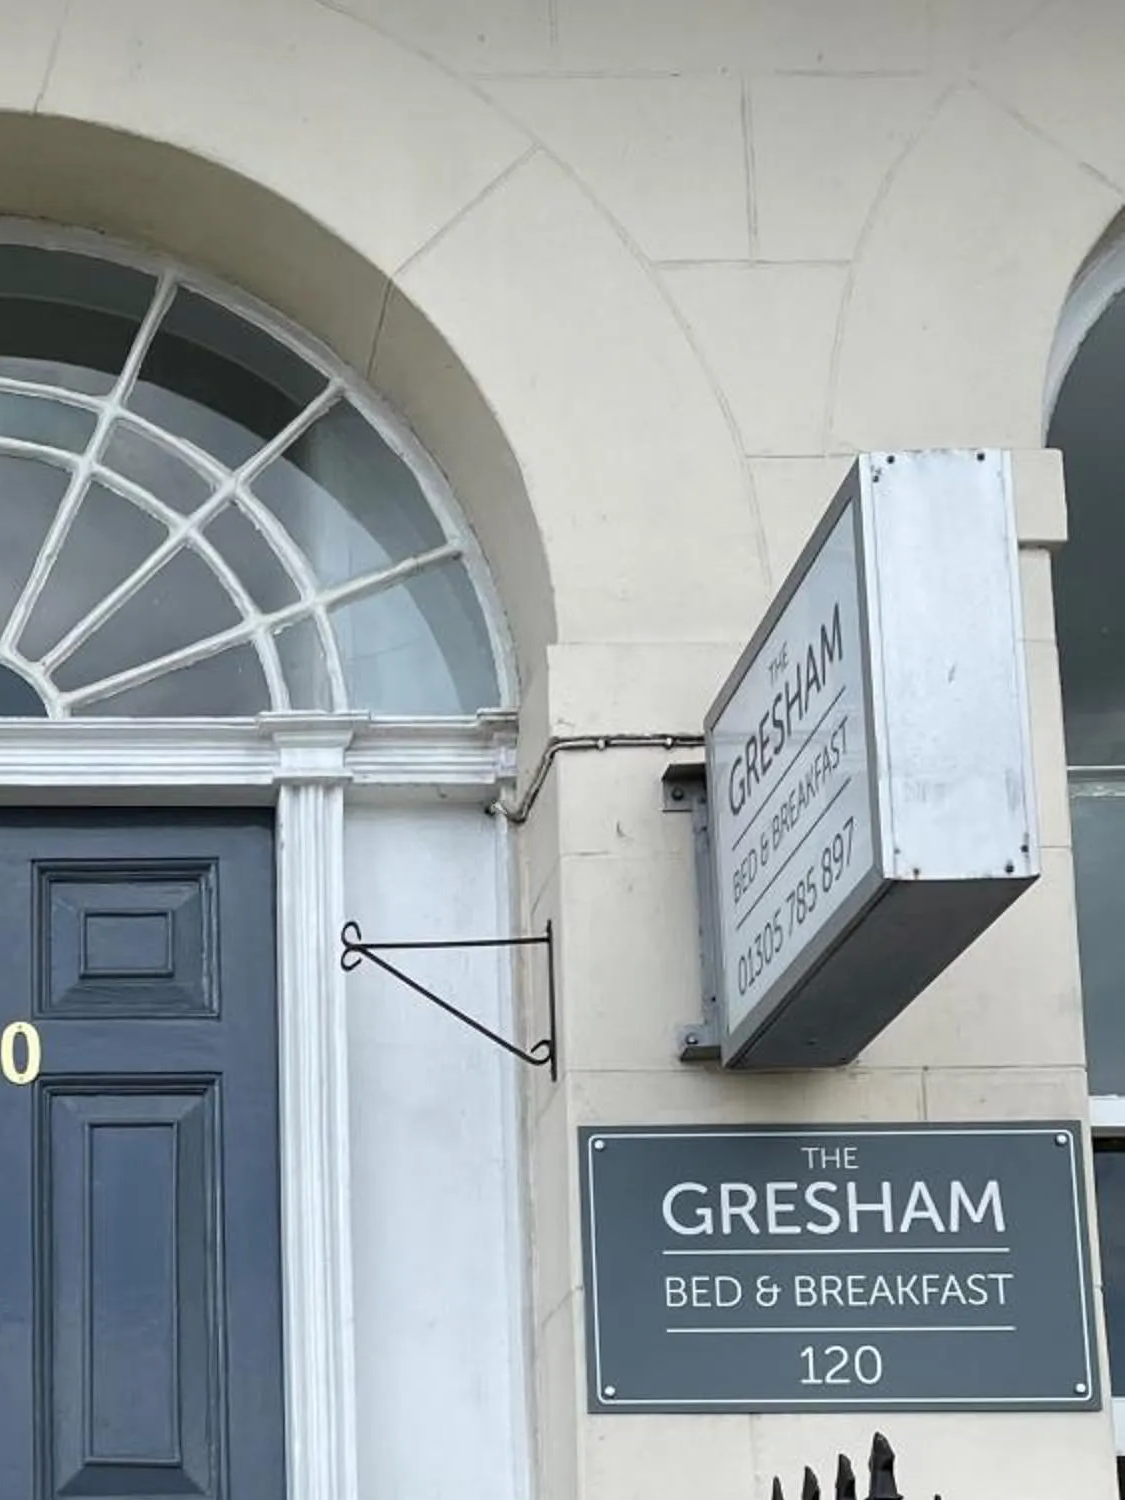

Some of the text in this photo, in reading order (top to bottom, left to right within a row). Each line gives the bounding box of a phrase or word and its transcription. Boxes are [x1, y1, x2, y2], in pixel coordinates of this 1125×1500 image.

[768, 640, 789, 686] THE
[729, 602, 843, 816] GRESHAM
[733, 715, 848, 903] BED & BREAKFAST
[738, 815, 855, 996] 01305 785 897
[800, 1147, 860, 1170] THE
[661, 1180, 1007, 1235] GRESHAM
[664, 1273, 1014, 1308] BED & BREAKFAST
[800, 1345, 883, 1385] 120
